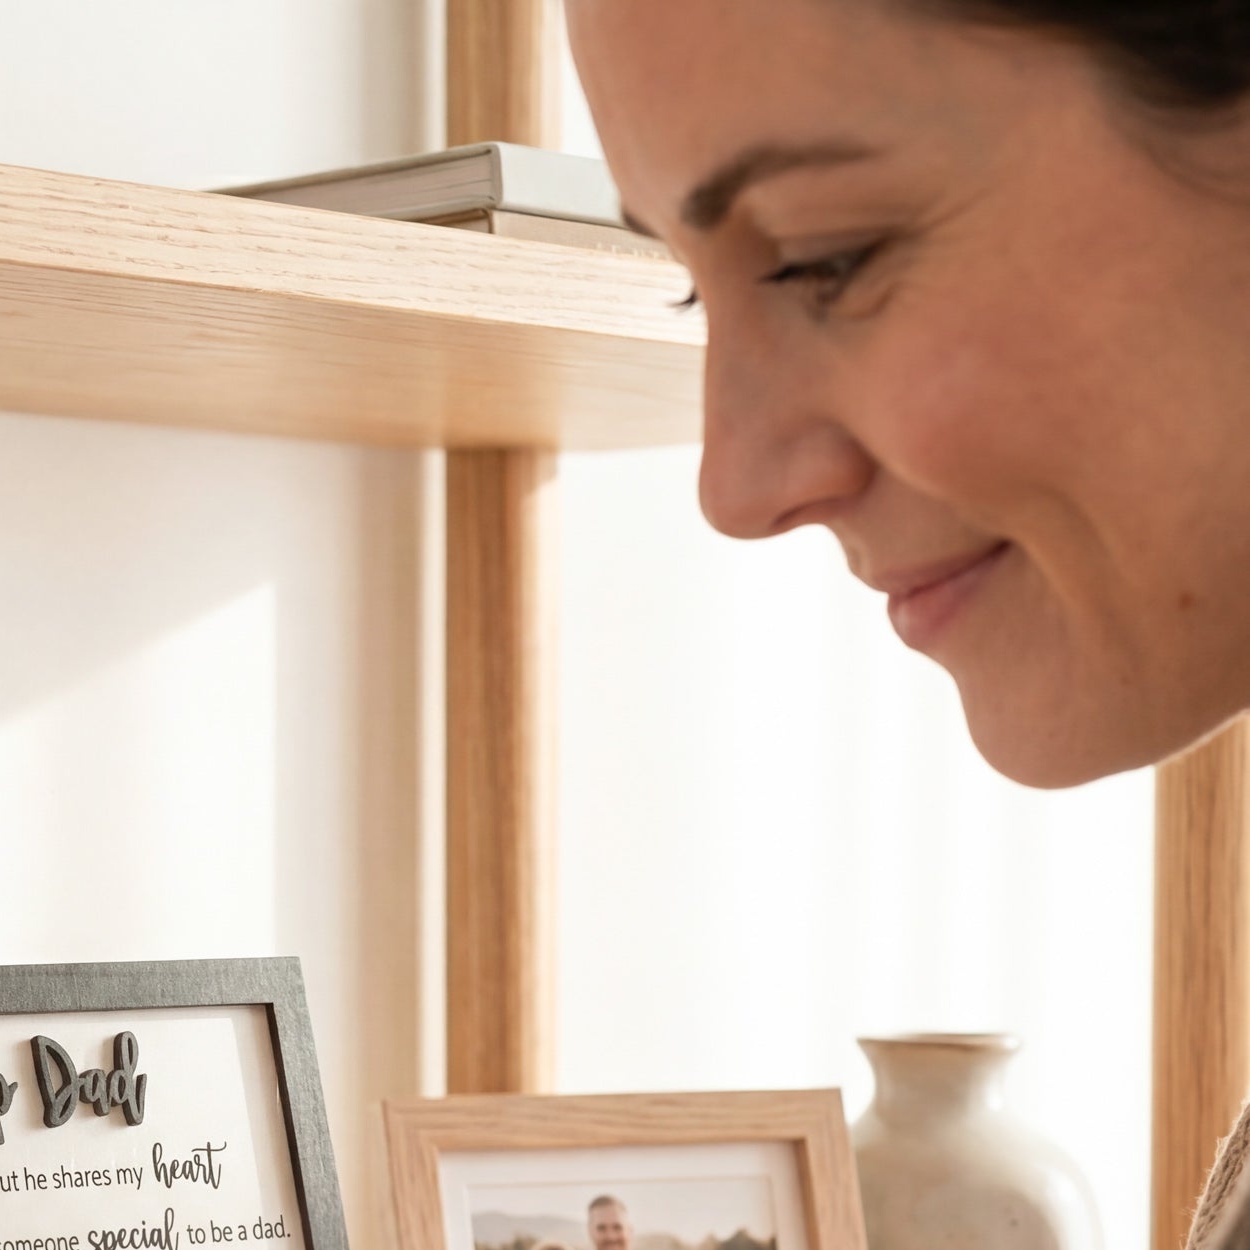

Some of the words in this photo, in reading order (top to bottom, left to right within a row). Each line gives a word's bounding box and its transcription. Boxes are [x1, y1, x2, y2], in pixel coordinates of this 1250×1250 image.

[30, 1031, 147, 1129] Dad
[23, 1166, 49, 1191] he
[52, 1163, 113, 1190] shares
[116, 1166, 144, 1189] my
[152, 1141, 227, 1190] heart
[186, 1224, 206, 1246] to
[210, 1220, 233, 1243] be
[237, 1223, 249, 1241] a
[252, 1214, 292, 1240] dad.
